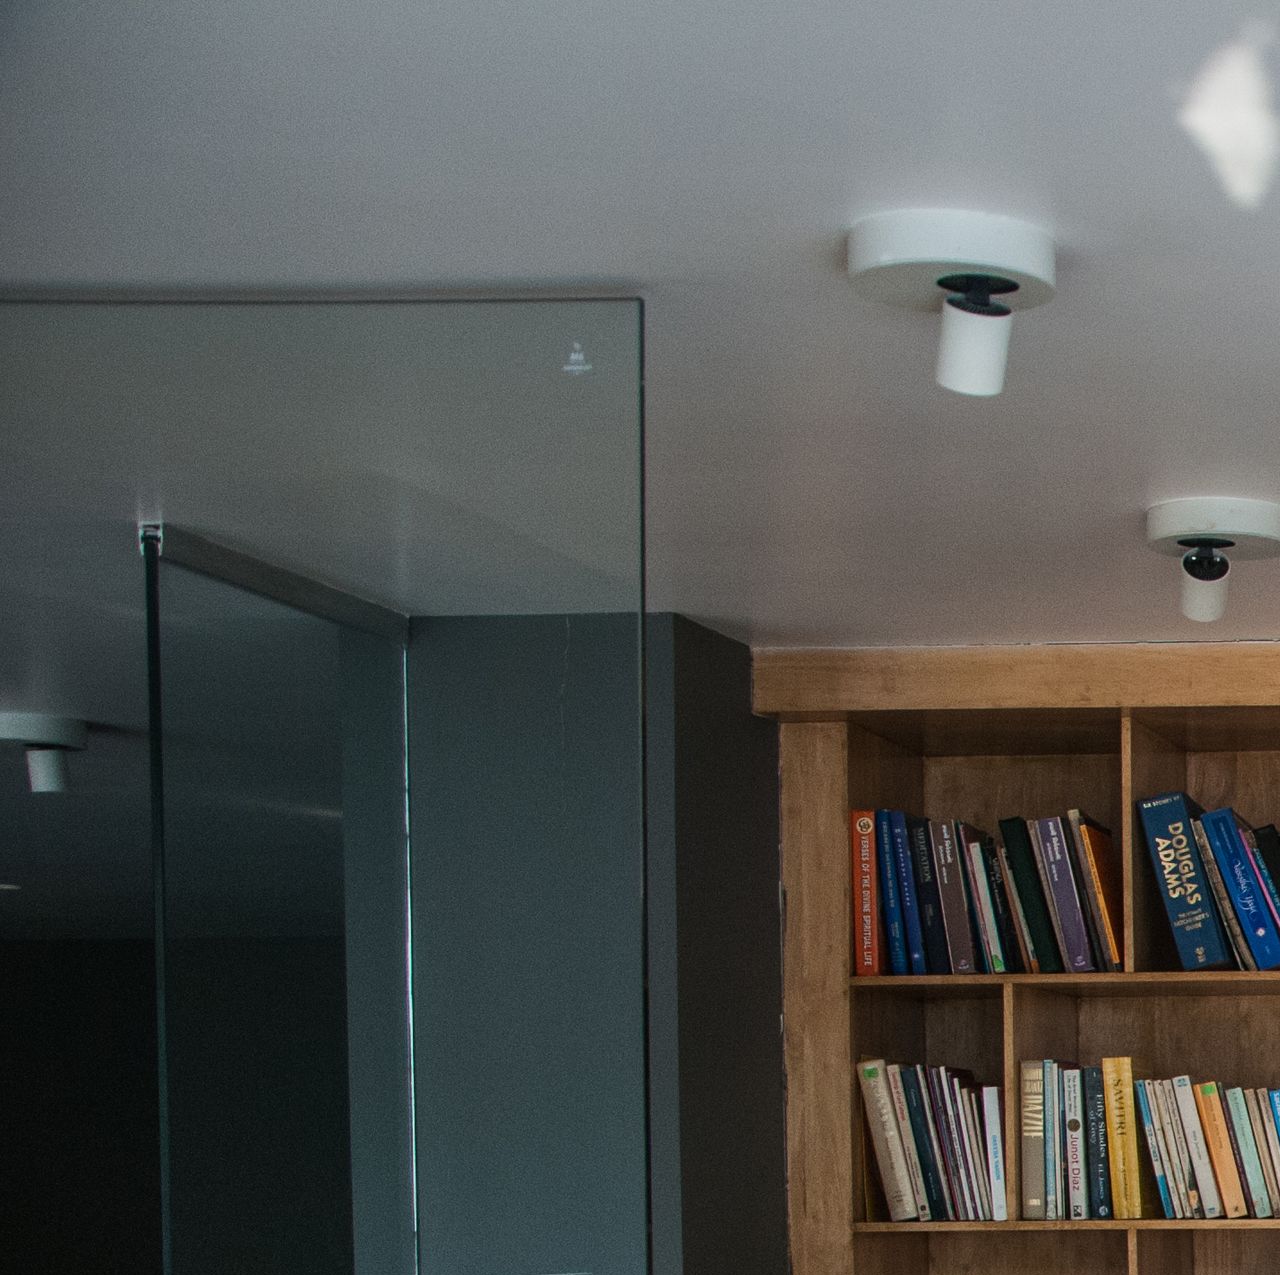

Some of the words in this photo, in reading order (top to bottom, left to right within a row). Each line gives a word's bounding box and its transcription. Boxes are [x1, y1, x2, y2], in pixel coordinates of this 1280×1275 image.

[861, 836, 869, 861] VERSES
[917, 828, 932, 882] MEDITATION
[862, 864, 869, 873] OF
[1155, 837, 1183, 899] ADAMS
[1167, 821, 1202, 905] DOUGLAS
[862, 875, 870, 888] THE
[862, 890, 871, 913] DIVINE
[864, 951, 872, 965] LIFE
[1096, 1094, 1104, 1119] Fifty
[1113, 1078, 1126, 1136] SAVITRI
[1070, 1134, 1079, 1164] Junot
[1098, 1121, 1106, 1158] Shades
